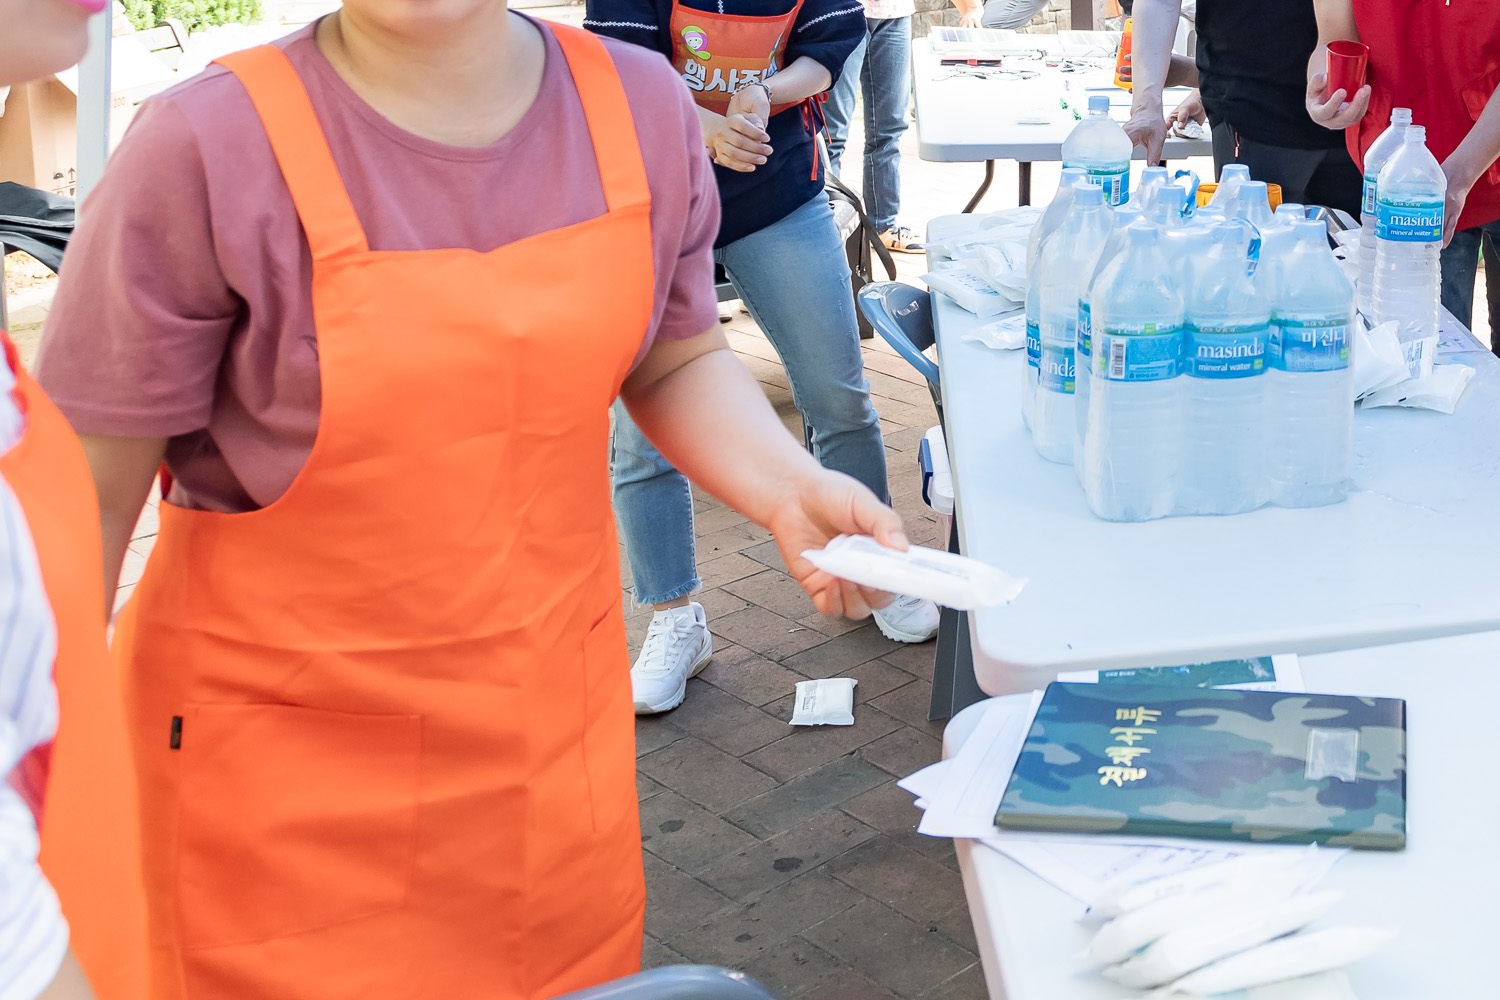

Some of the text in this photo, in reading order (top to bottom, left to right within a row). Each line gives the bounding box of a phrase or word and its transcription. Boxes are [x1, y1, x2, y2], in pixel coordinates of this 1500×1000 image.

[1390, 212, 1442, 227] masinda
[1197, 337, 1265, 359] masinda
[1198, 363, 1251, 372] mineral water
